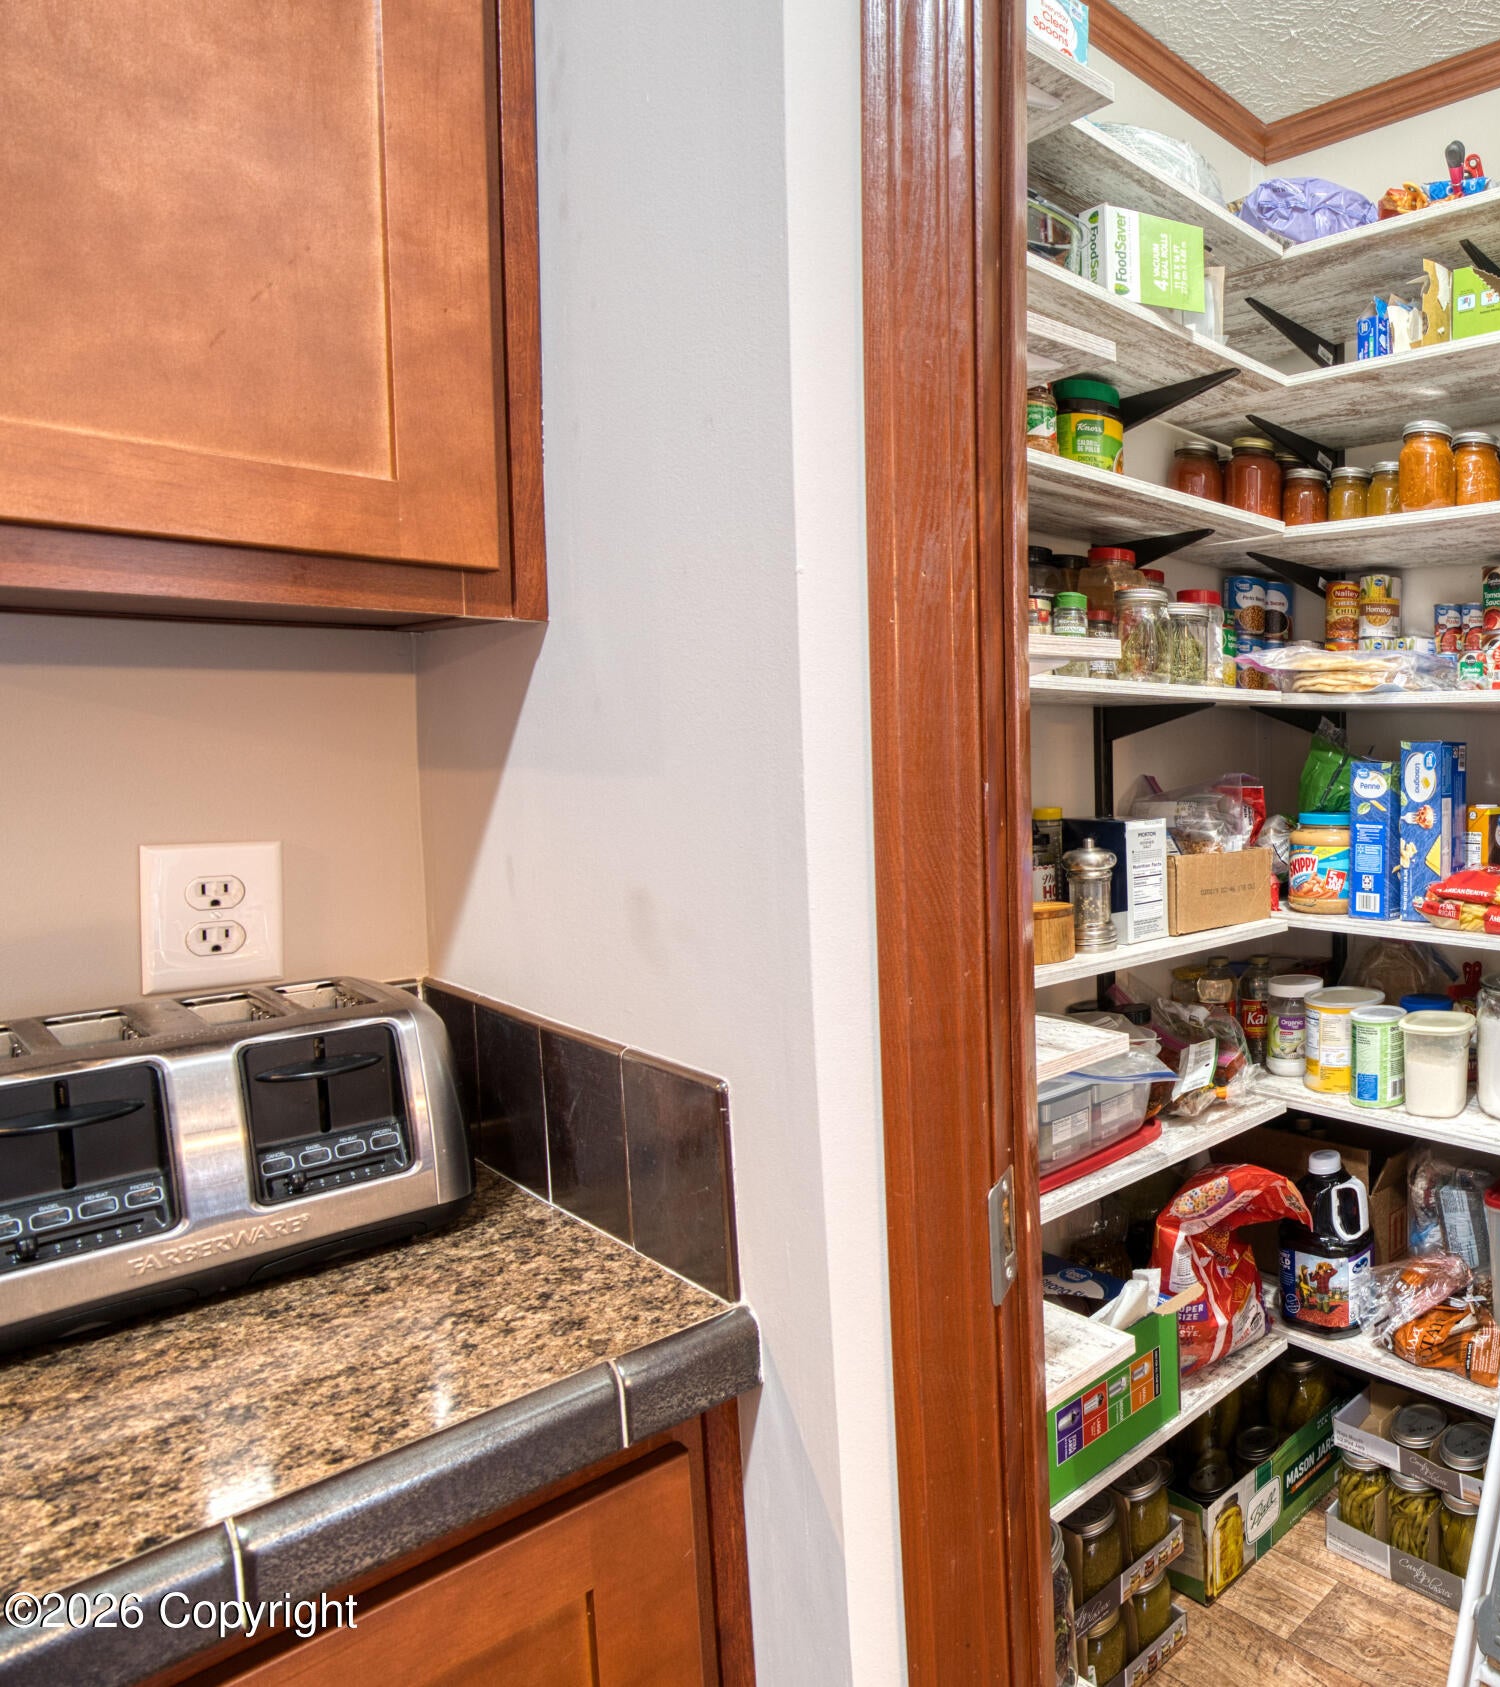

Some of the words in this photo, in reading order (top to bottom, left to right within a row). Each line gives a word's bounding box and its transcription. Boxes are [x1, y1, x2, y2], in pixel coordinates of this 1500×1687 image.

[1033, 15, 1069, 47] Spoons
[1042, 10, 1069, 36] Clear
[1114, 212, 1128, 283] FoodSaver
[1160, 232, 1168, 259] ROLLS
[1152, 243, 1160, 277] VACUUM
[1153, 279, 1168, 292] 4
[1077, 422, 1103, 433] Knorr
[1335, 589, 1359, 599] Nalley
[1335, 608, 1357, 616] CHILI
[1365, 604, 1391, 616] Hominy
[1360, 782, 1381, 790] Penne
[1413, 763, 1421, 793] Lasagna
[1289, 857, 1317, 878] SKIPPY
[1247, 1011, 1267, 1026] Kar
[1280, 1019, 1304, 1029] Organic
[265, 1151, 287, 1160] CANCEL
[127, 1214, 304, 1277] FARBERWARE
[1285, 1451, 1315, 1489] MASON
[1250, 1487, 1278, 1531] Ball
